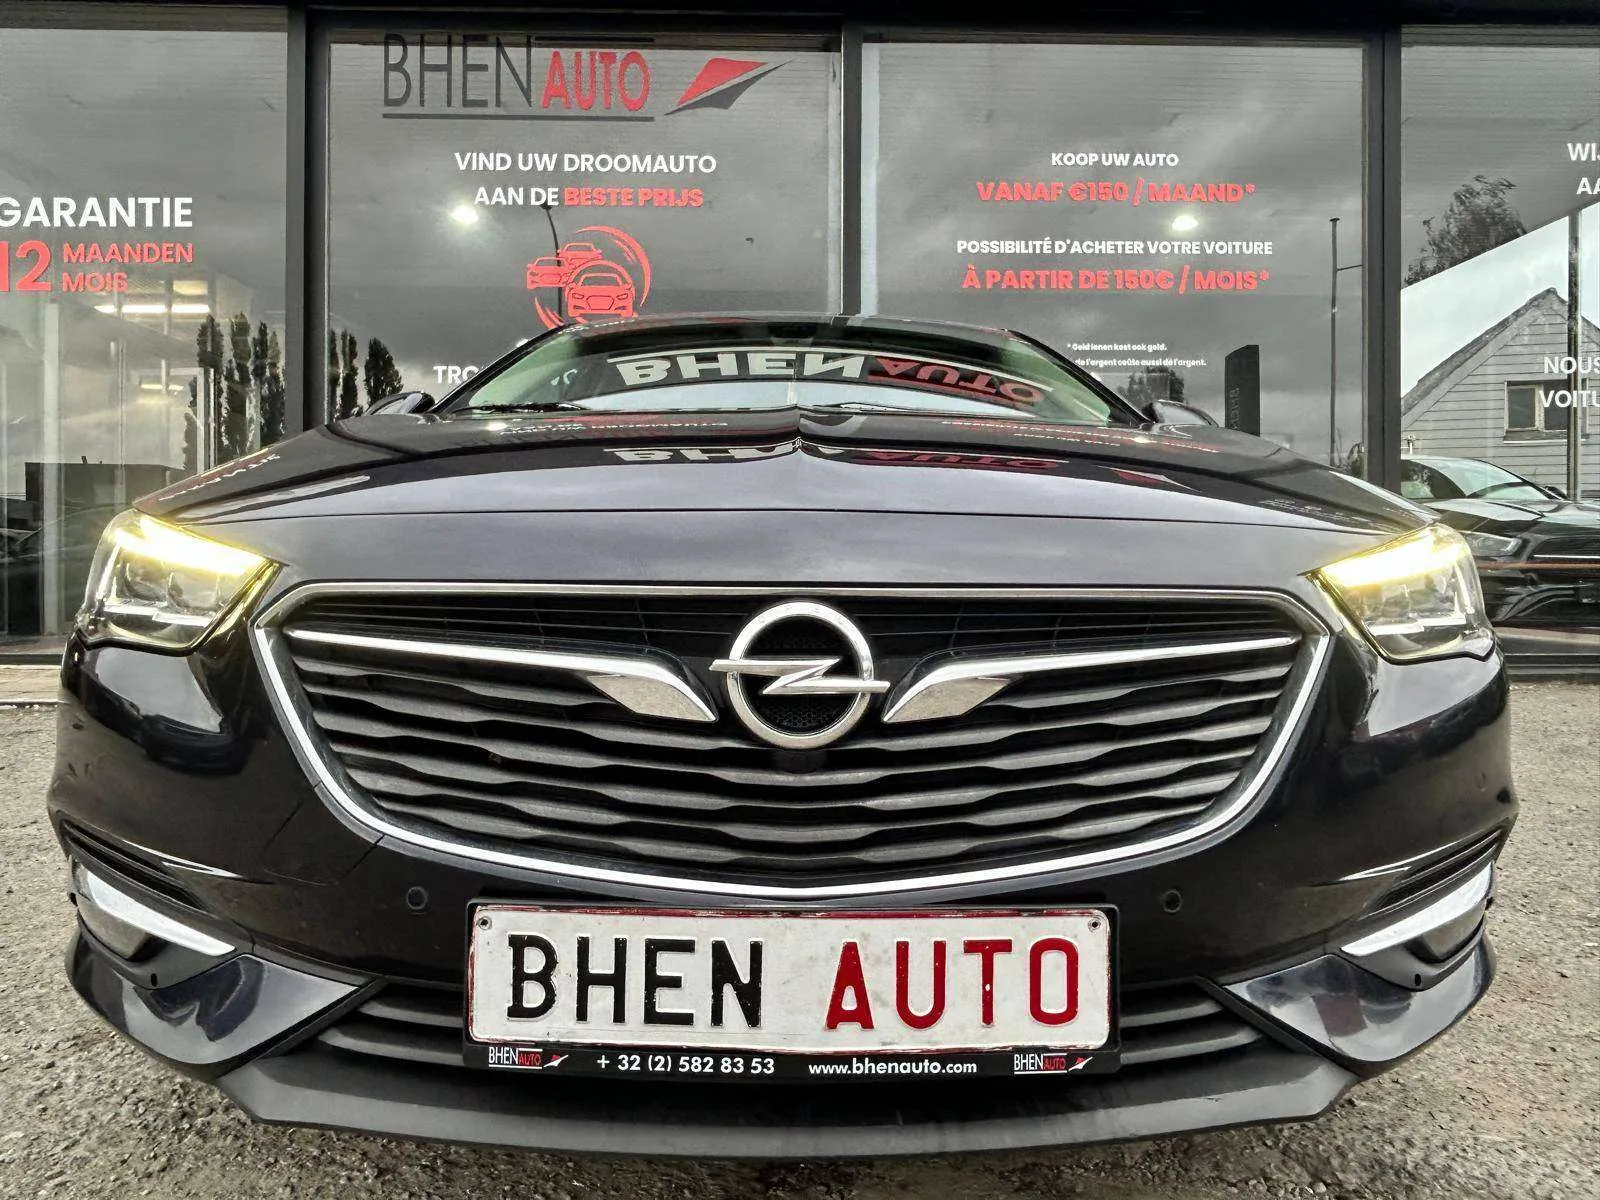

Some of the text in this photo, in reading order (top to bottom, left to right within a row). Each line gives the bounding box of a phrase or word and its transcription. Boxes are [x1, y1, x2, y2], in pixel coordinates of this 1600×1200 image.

[383, 33, 650, 111] BHEN AUTO
[454, 152, 717, 173] VIND UW DROOMAUTO
[1051, 152, 1179, 167] KOOP UW AUTO
[474, 186, 704, 208] AAN DE BESTE PRIJS
[976, 181, 1064, 202] VANAF
[1068, 181, 1129, 202] €150
[1132, 177, 1145, 207] /
[0, 196, 193, 228] GARANTIE
[62, 242, 194, 264] MAANDEN
[957, 237, 1273, 255] POSSIBILITÉ D'ACHETER VOTRE VOITURE
[61, 271, 128, 292] MOIS
[986, 269, 1073, 290] PARTIR
[1078, 270, 1109, 289] DE
[1114, 269, 1175, 290] 150€
[1178, 265, 1191, 295] /
[433, 365, 484, 384] TRO
[506, 932, 1080, 1030] BHEN AUTO
[488, 1046, 542, 1066] BHEN AUTO
[597, 1055, 775, 1074] + 32 (2) 582 83 53
[808, 1058, 977, 1075] www.bhenauto.com
[1013, 1054, 1044, 1071] BHEN
